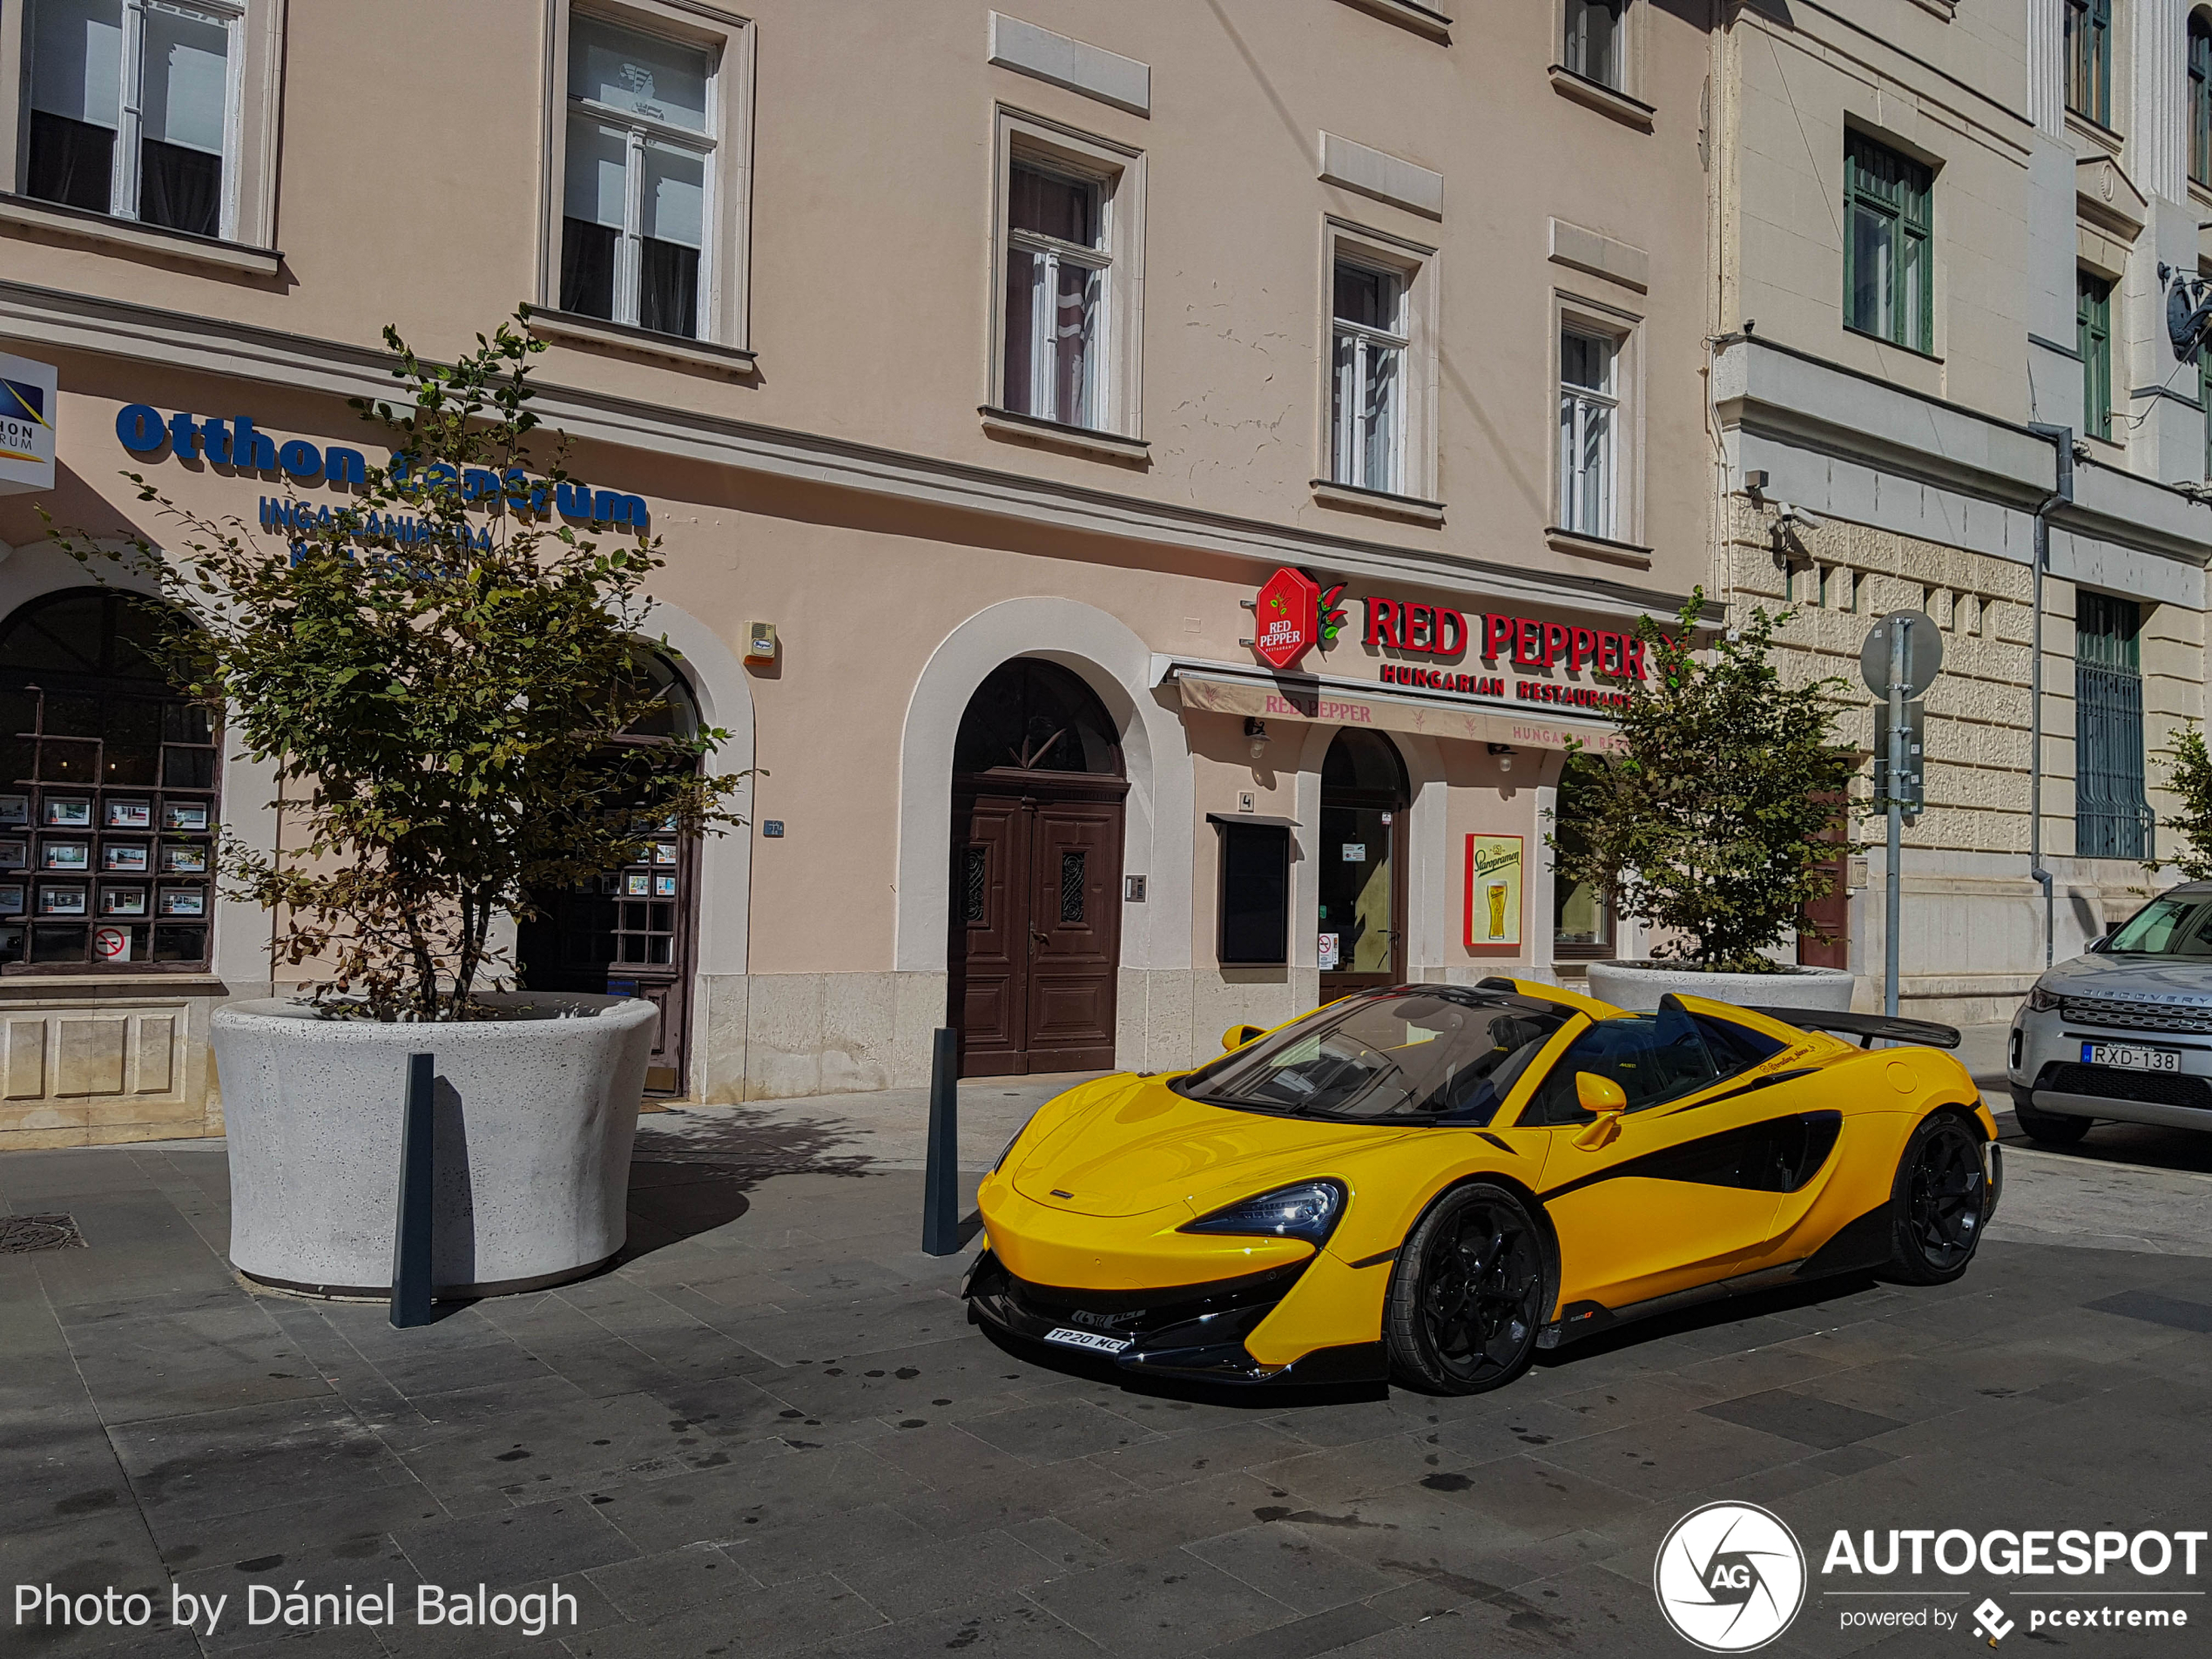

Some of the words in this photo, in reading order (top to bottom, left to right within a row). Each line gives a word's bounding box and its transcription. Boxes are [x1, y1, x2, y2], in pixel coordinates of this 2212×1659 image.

[116, 404, 365, 484] Otthon
[388, 451, 647, 527] Centrum
[1269, 619, 1291, 634] RED
[1260, 630, 1300, 647] PEPPER
[1363, 596, 1468, 656] RED
[1482, 613, 1648, 680] PEPPER
[1382, 664, 1505, 697] HUNGARIAN
[1518, 680, 1632, 711] RESTAURANT
[1265, 694, 1302, 715] RED
[1307, 699, 1372, 723] PEPPER
[1513, 726, 1591, 747] HUNGARAN
[1243, 794, 1251, 808] 4
[1474, 849, 1520, 873] Staropramen
[2082, 989, 2209, 1005] DISCOVERY
[2094, 1048, 2175, 1069] RXD-138
[1051, 1329, 1093, 1344] TP20
